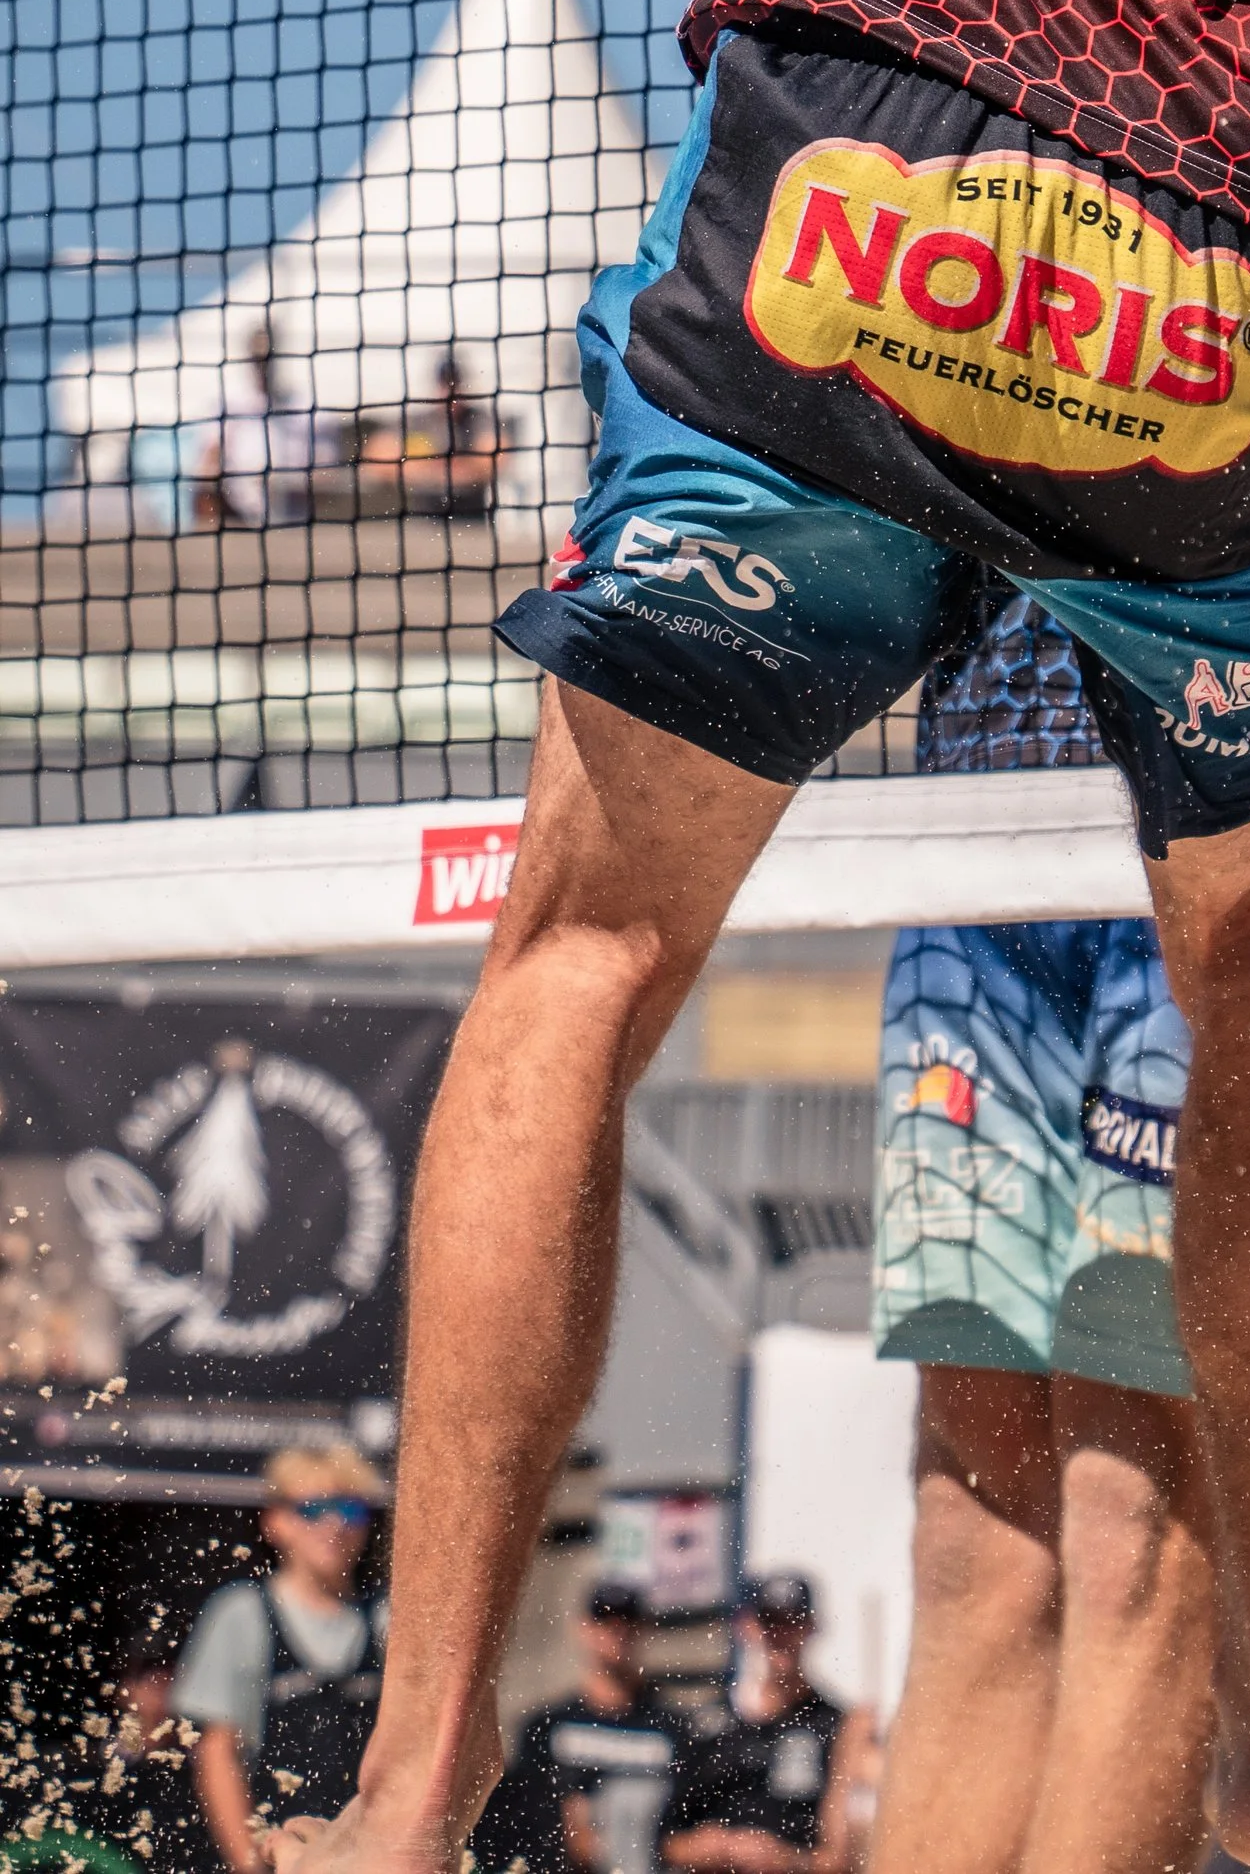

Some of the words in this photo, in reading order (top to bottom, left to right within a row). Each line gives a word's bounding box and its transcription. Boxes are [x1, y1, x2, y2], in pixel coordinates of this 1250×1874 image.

[956, 176, 1043, 208] SEIT
[1062, 189, 1144, 254] 1931
[781, 181, 1243, 407] NORIS
[853, 328, 1166, 443] FEUERLÖSCHER
[745, 648, 783, 671] AG
